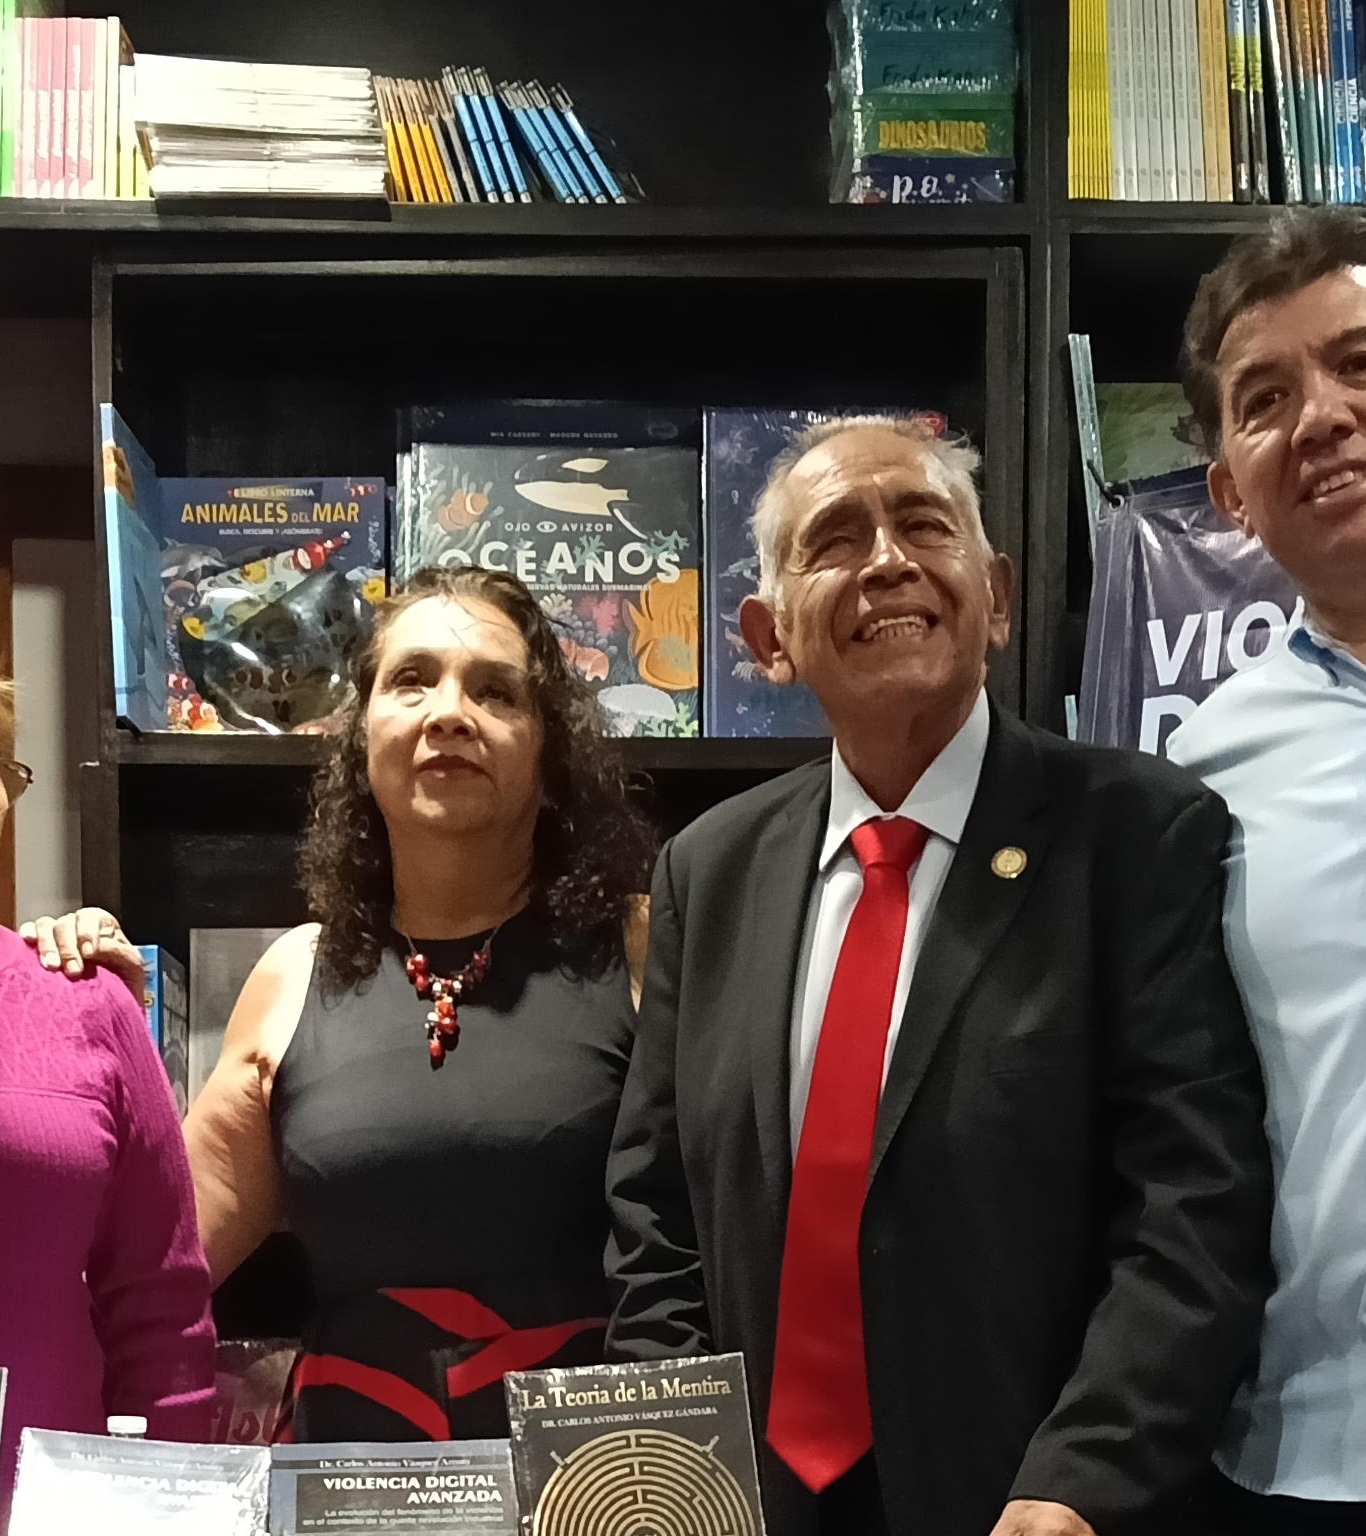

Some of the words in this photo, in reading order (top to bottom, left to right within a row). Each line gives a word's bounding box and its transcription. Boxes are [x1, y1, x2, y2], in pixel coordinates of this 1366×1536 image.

[1347, 77, 1359, 124] CIENCIA
[878, 120, 987, 150] DINOSAURIOS
[181, 502, 288, 524] ANIMALES
[291, 513, 311, 523] DEL
[312, 502, 360, 523] MAR
[504, 522, 531, 532] OJO
[561, 522, 614, 532] AVIZOR
[1147, 600, 1288, 687] VIO
[523, 1390, 546, 1410] La
[614, 1381, 636, 1403] de
[640, 1381, 658, 1400] la
[660, 1374, 732, 1399] Mentira
[323, 1477, 421, 1490] VIOLENCIA
[425, 1475, 498, 1489] DIGITAL
[406, 1490, 503, 1505] AVANZADA
